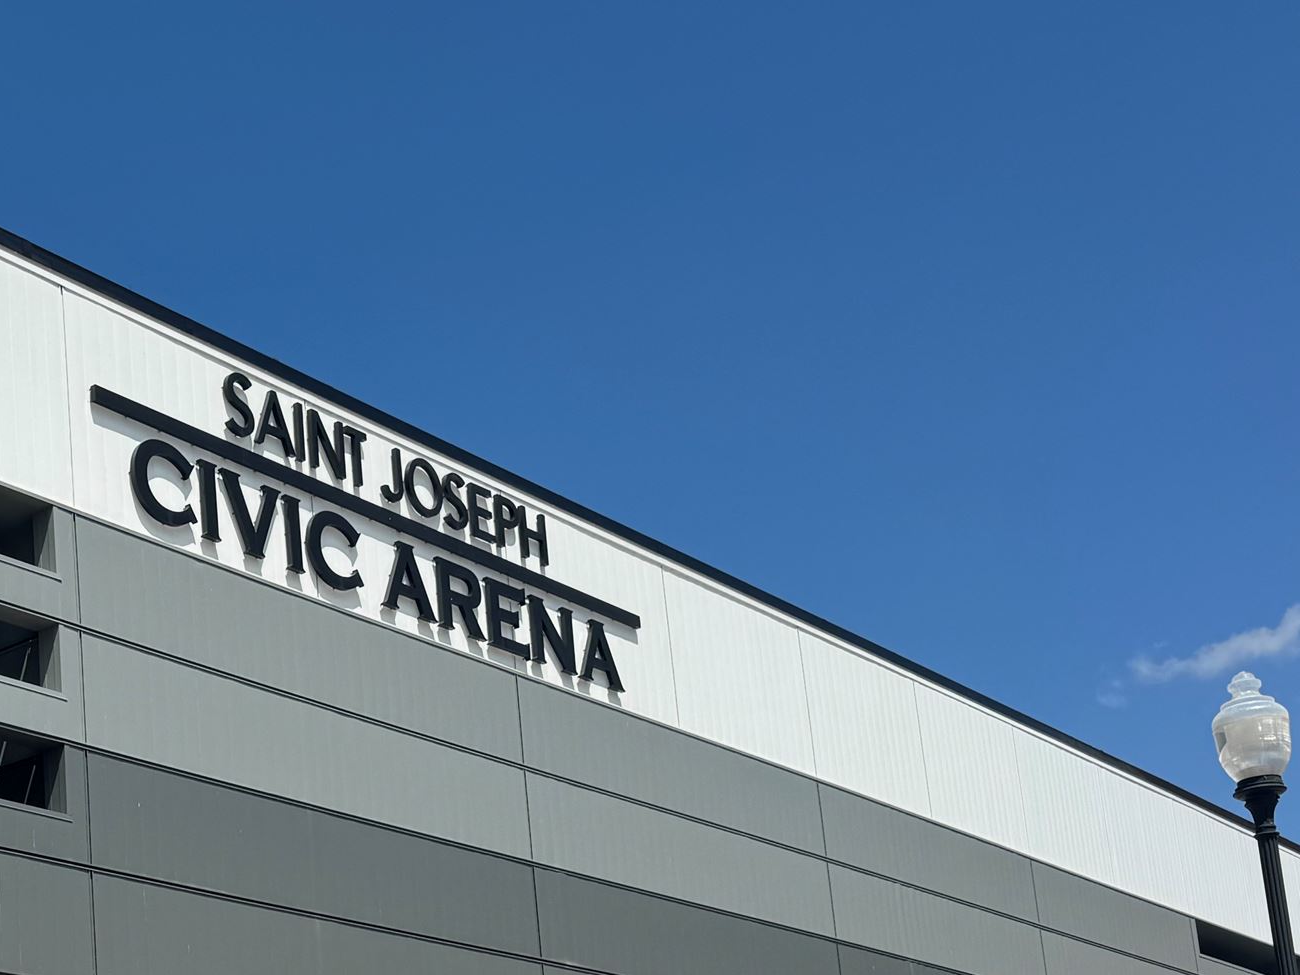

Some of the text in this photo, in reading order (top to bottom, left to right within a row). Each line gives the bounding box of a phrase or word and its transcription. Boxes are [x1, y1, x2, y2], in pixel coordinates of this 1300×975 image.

[130, 438, 625, 693] CIVIC ARENA
[221, 372, 549, 567] SAINT JOSEPH
